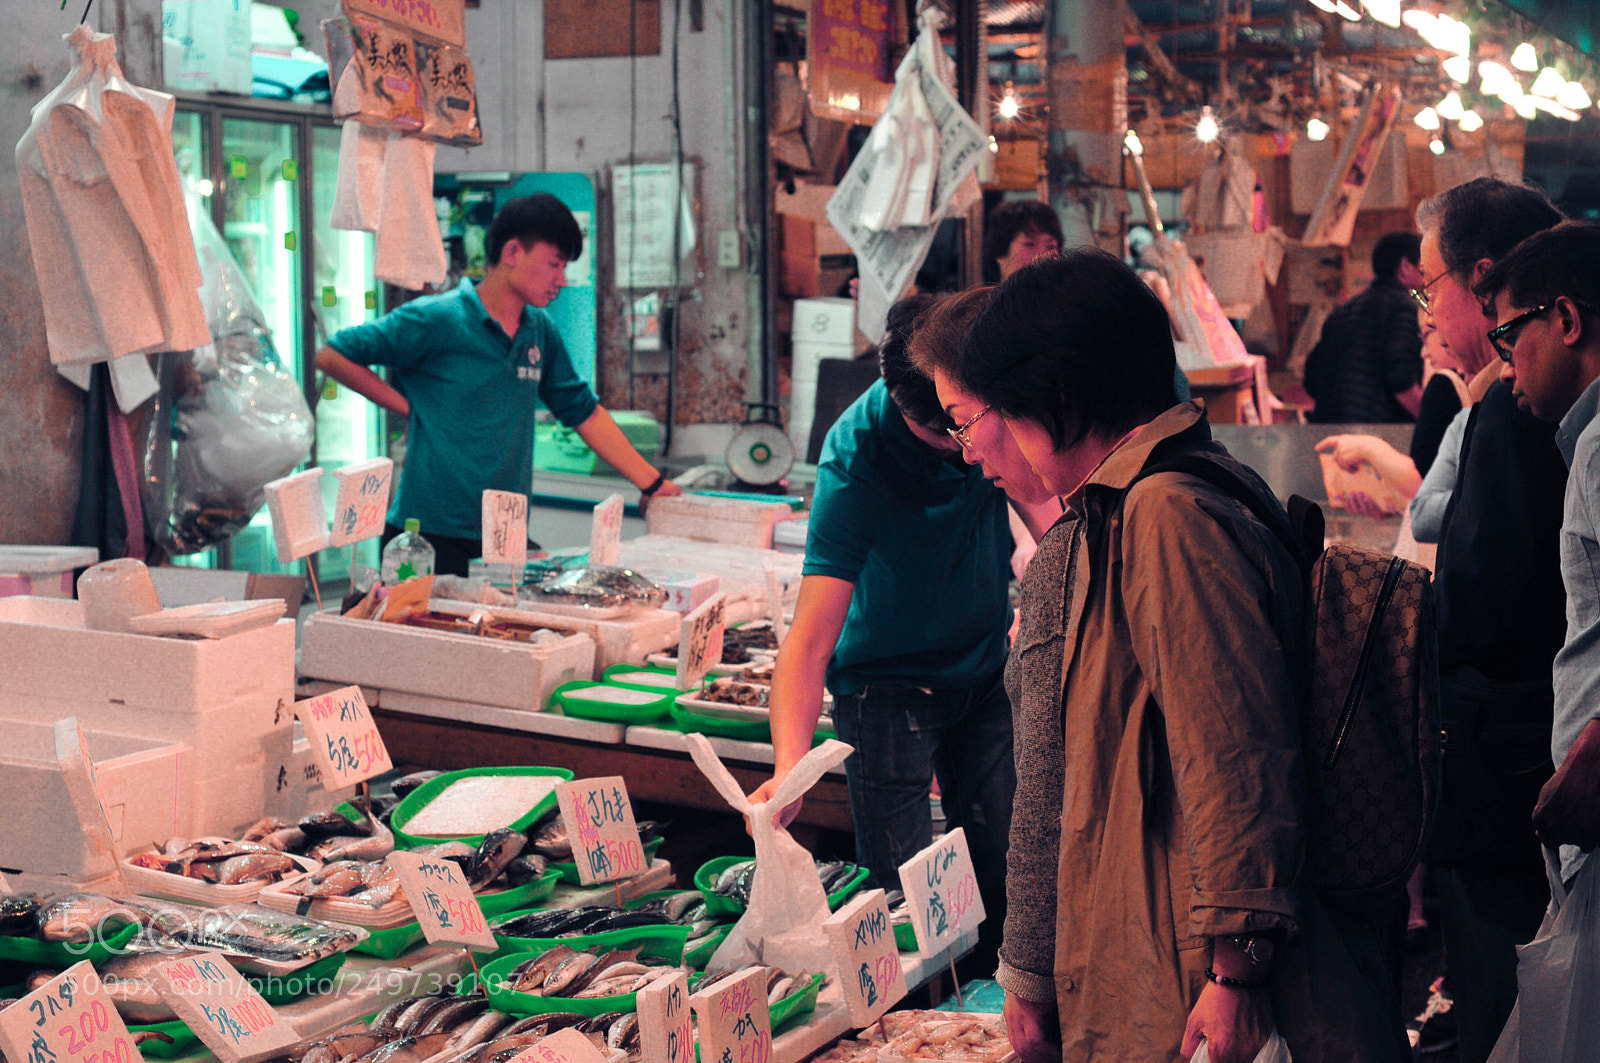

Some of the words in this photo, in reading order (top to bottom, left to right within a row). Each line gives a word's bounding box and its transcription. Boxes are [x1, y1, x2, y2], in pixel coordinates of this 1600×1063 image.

[356, 499, 385, 535] 500
[353, 729, 384, 774] 500
[587, 786, 628, 828] さんま
[418, 860, 459, 885] カマス
[605, 839, 641, 879] 500
[445, 893, 483, 937] 500
[948, 873, 975, 931] 500
[30, 974, 78, 1027] コハダ
[875, 951, 898, 1005] 500
[59, 1000, 109, 1055] 200
[231, 993, 275, 1038] 1000
